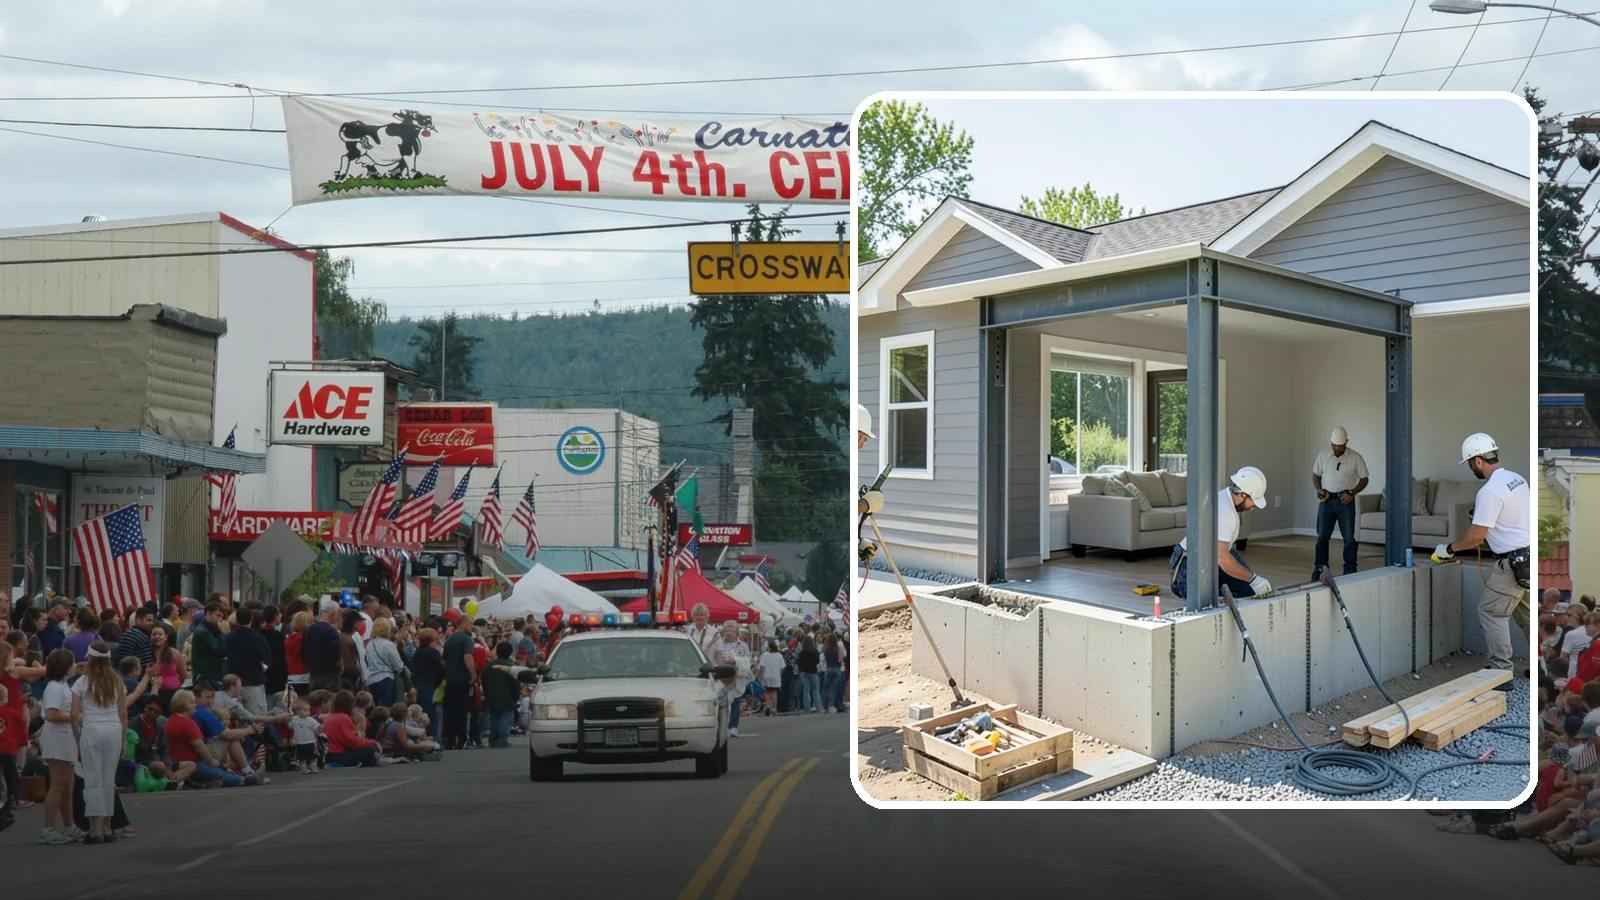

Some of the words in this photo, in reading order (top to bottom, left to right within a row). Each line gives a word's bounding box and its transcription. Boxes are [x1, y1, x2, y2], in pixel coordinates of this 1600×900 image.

[481, 141, 605, 193] JULY
[632, 150, 746, 197] 4th.
[697, 254, 850, 280] CROSSWA
[282, 380, 373, 419] ACE
[405, 409, 453, 422] CEDAR
[283, 421, 371, 436] Hardware
[416, 428, 476, 447] Coca-Cola
[353, 467, 386, 480] Simpl
[95, 485, 124, 494] Vincent
[125, 486, 136, 494] de
[138, 486, 155, 495] Paul
[688, 526, 741, 535] CRNATION
[699, 535, 730, 543] GLASS
